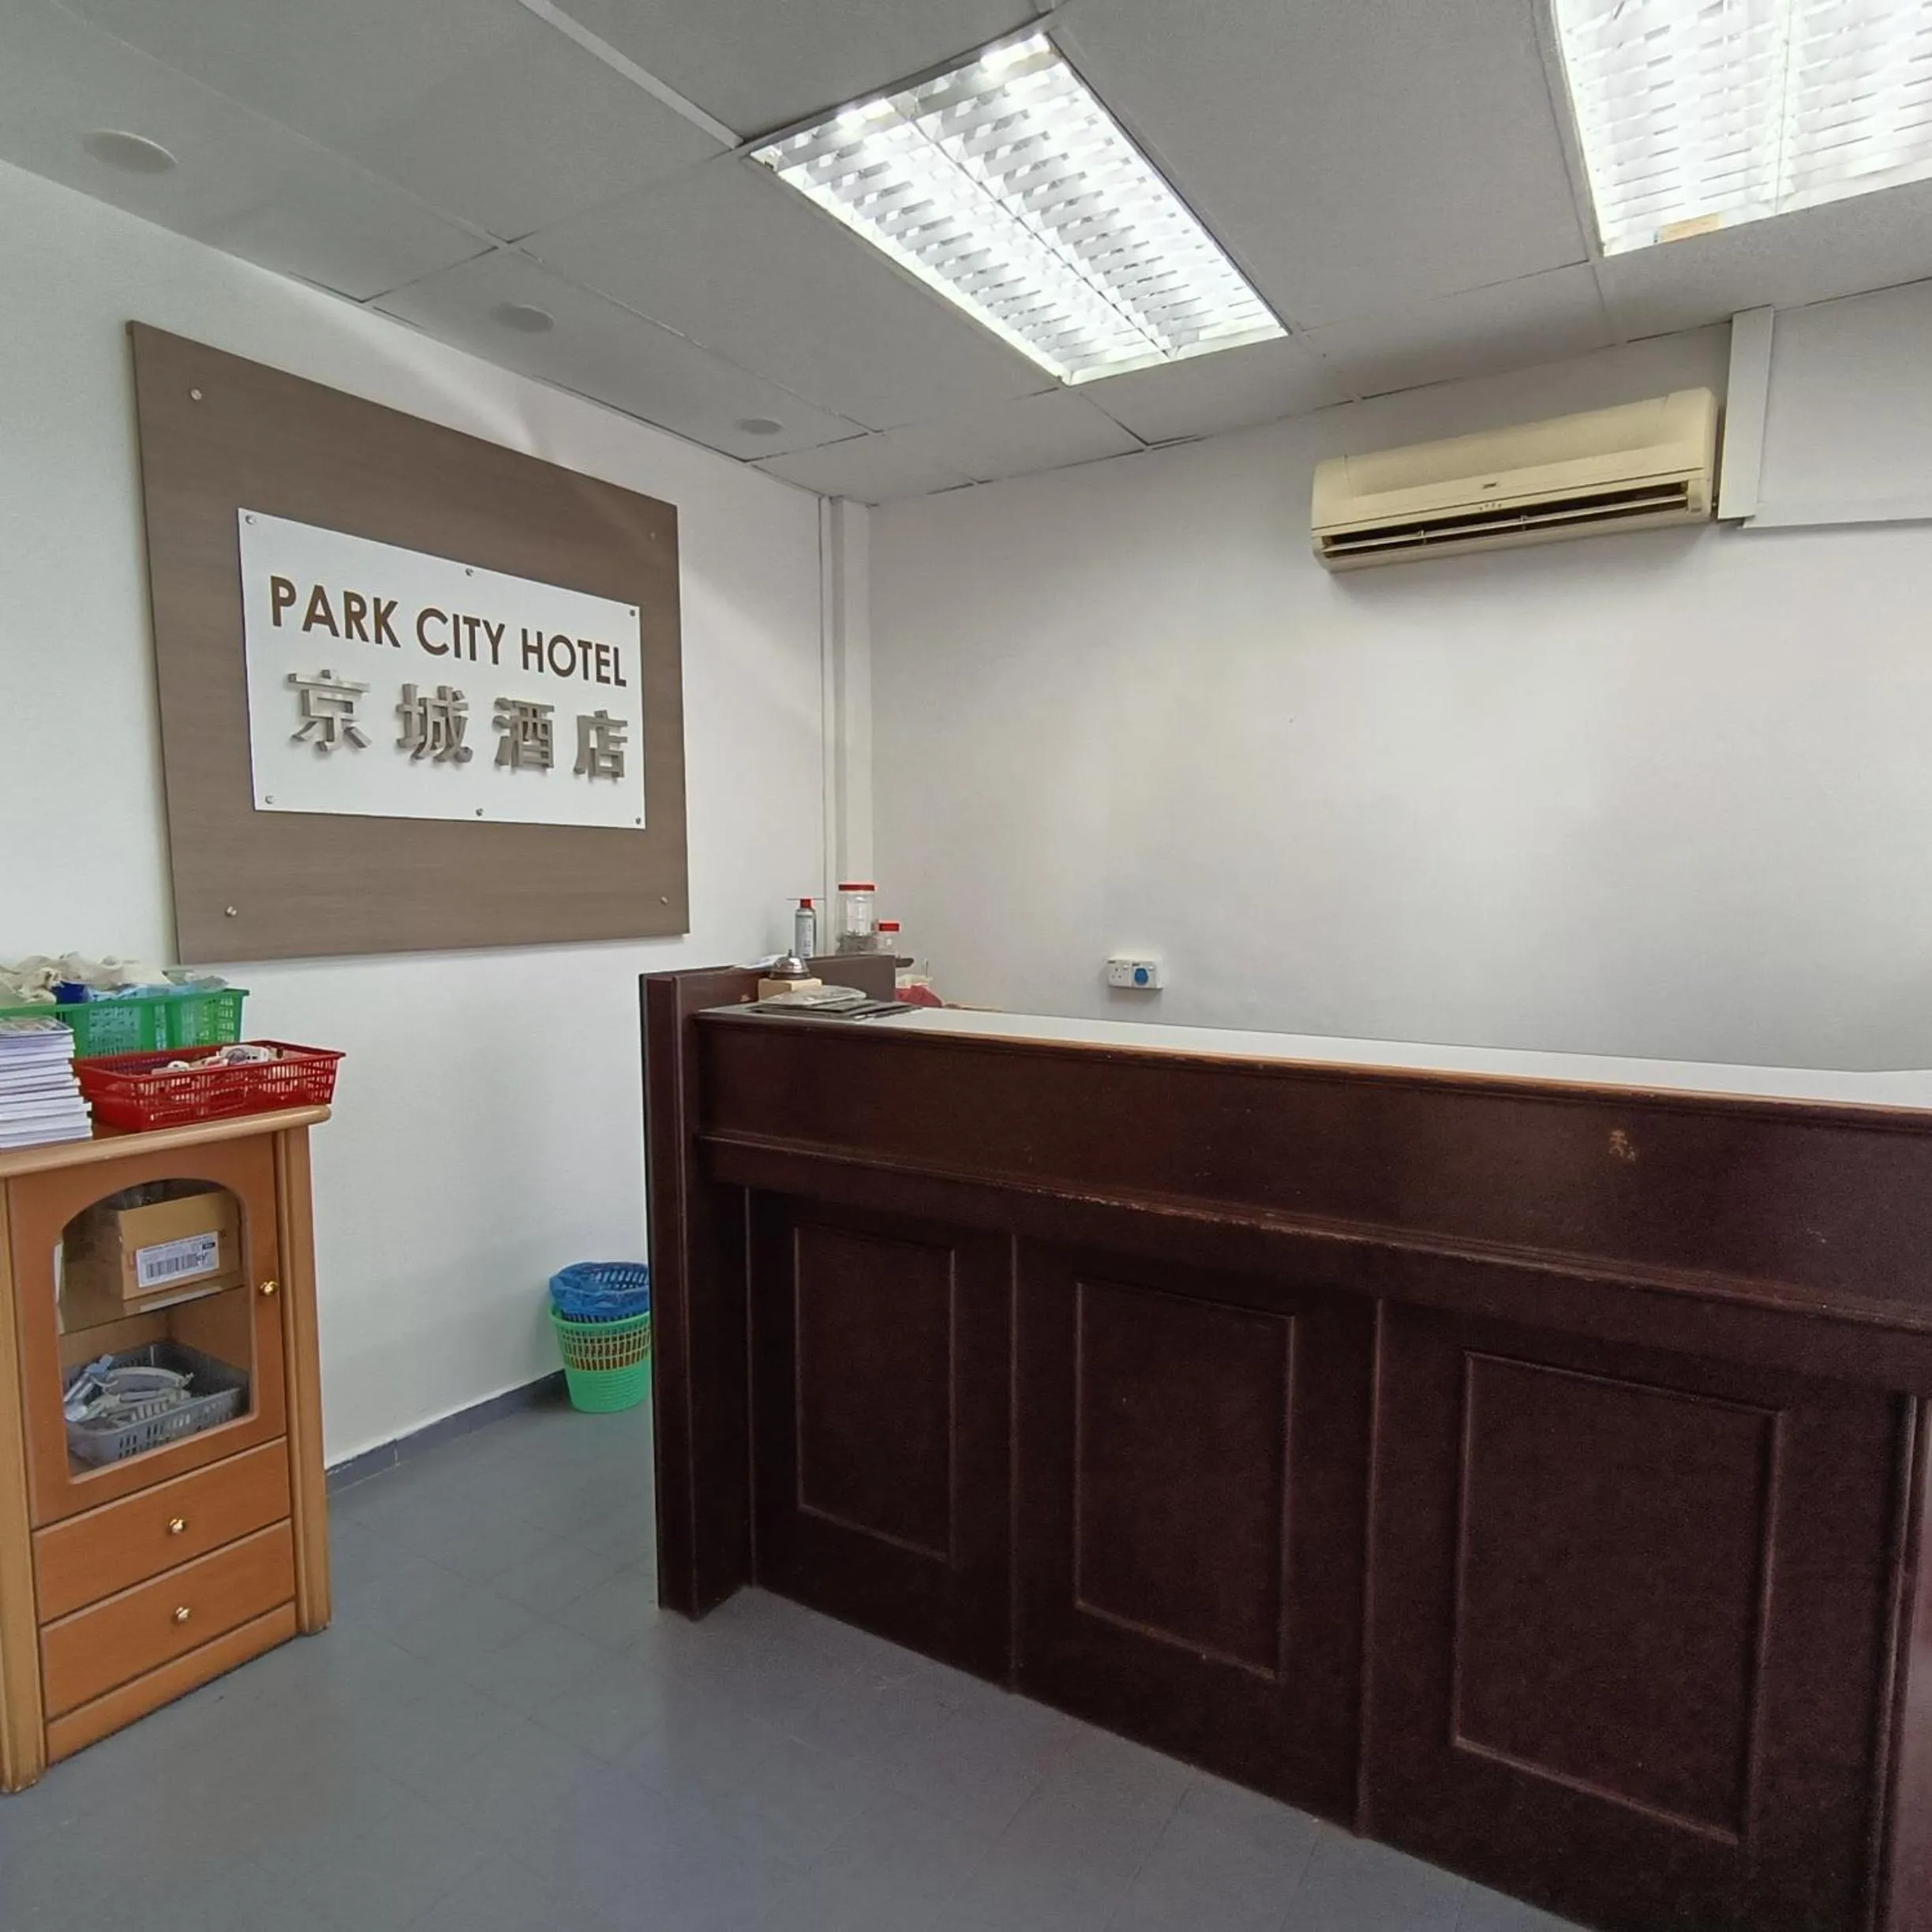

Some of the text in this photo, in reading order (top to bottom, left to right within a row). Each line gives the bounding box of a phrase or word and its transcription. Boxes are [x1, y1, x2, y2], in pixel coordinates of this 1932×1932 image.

[270, 575, 627, 687] PARK CITY HOTEL
[287, 669, 628, 780] 京城酒店
